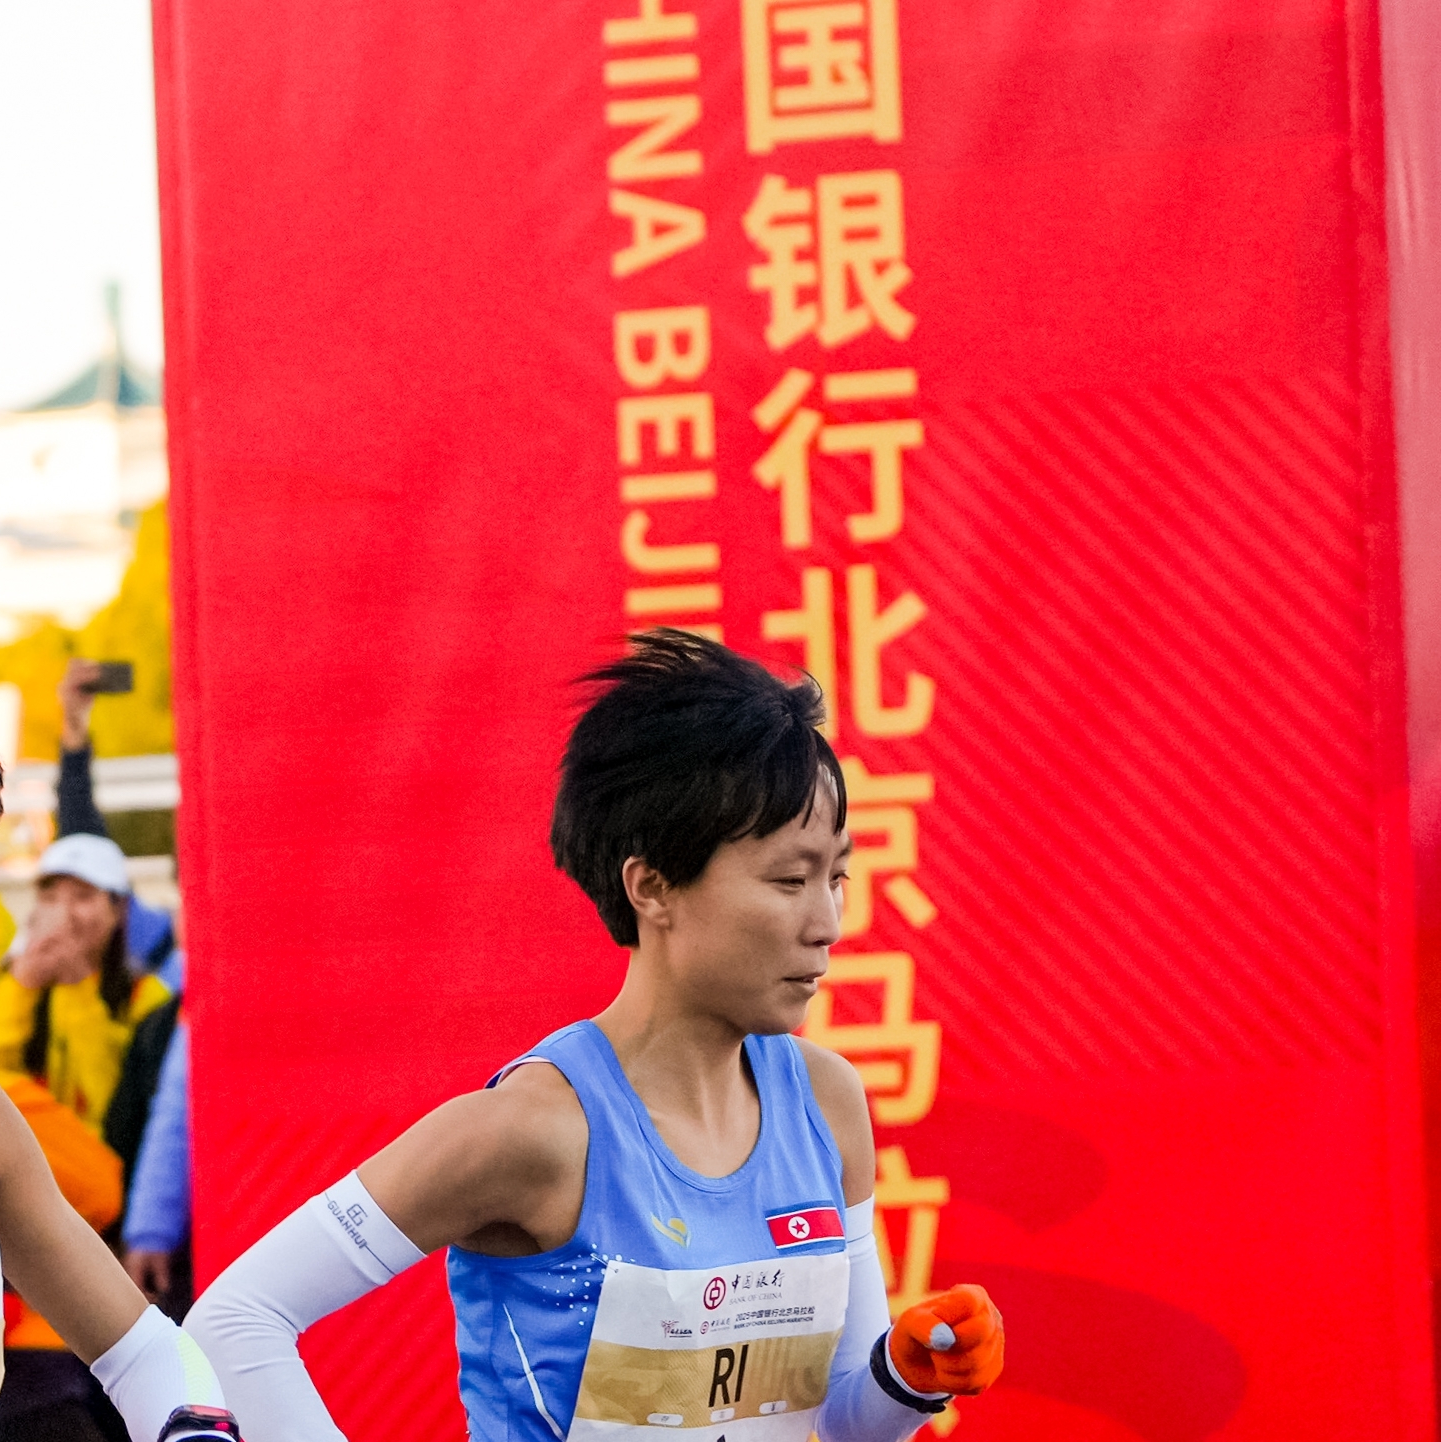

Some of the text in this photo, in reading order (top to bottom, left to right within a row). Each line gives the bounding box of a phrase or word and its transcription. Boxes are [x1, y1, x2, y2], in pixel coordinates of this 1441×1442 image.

[614, 305, 724, 655] BEIJI
[730, 1269, 786, 1293] 中国银行
[708, 1344, 749, 1408] RI
